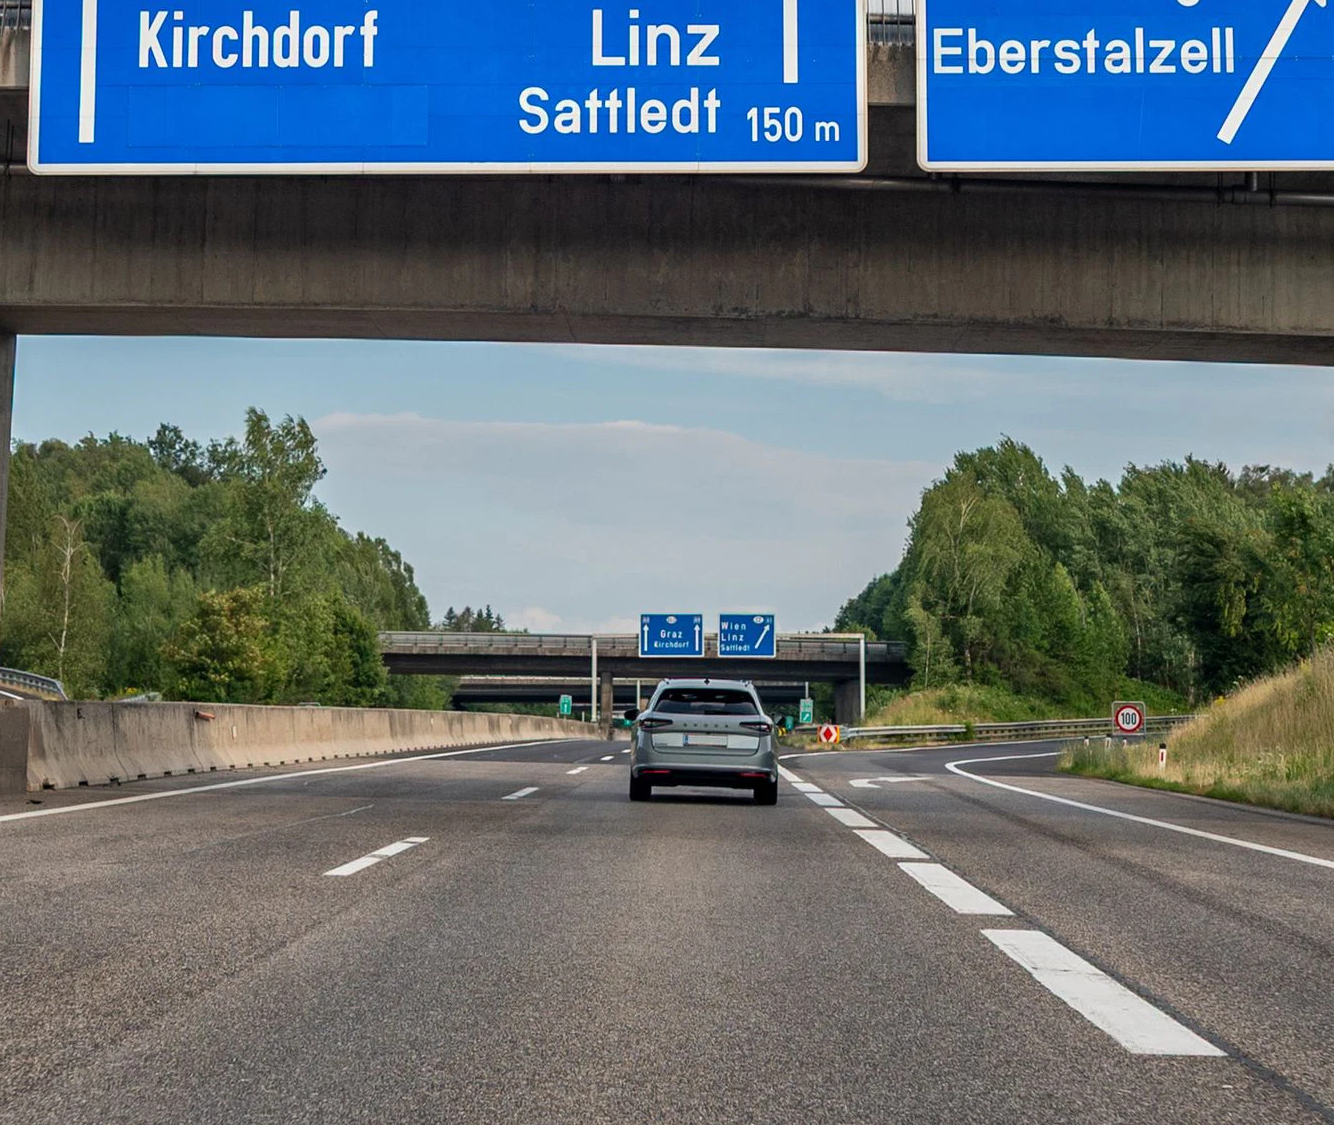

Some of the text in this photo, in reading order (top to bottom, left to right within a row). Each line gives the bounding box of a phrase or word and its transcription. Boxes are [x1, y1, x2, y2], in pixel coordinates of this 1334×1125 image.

[138, 9, 378, 68] Kirchdorf
[592, 9, 720, 66] Linz
[933, 27, 1235, 74] Eberstalzell
[518, 86, 721, 134] Sattledt
[746, 106, 840, 142] 150 m
[660, 629, 683, 639] Graz
[721, 622, 746, 631] Wien
[721, 633, 744, 642] Linz
[1121, 712, 1137, 725] 100
